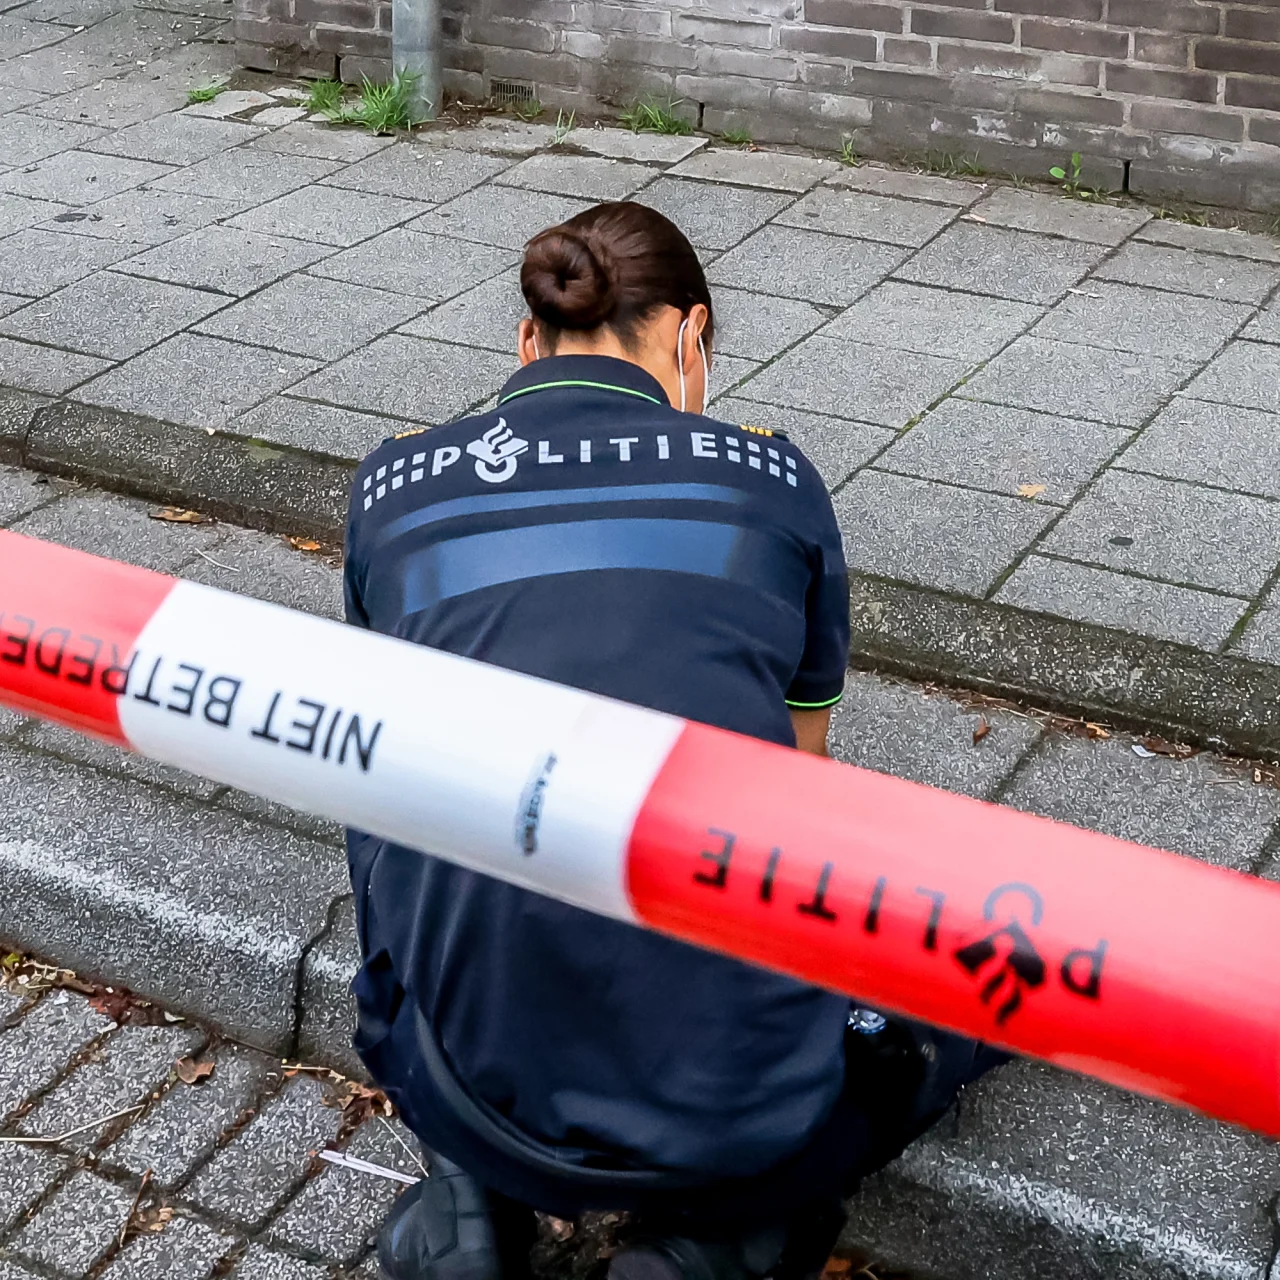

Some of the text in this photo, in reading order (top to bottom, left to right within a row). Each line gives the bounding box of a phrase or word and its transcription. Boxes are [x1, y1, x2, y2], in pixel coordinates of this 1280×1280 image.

[431, 416, 718, 484] POLITIE
[251, 690, 383, 773] NIET
[693, 826, 1109, 1025] POLITIE
